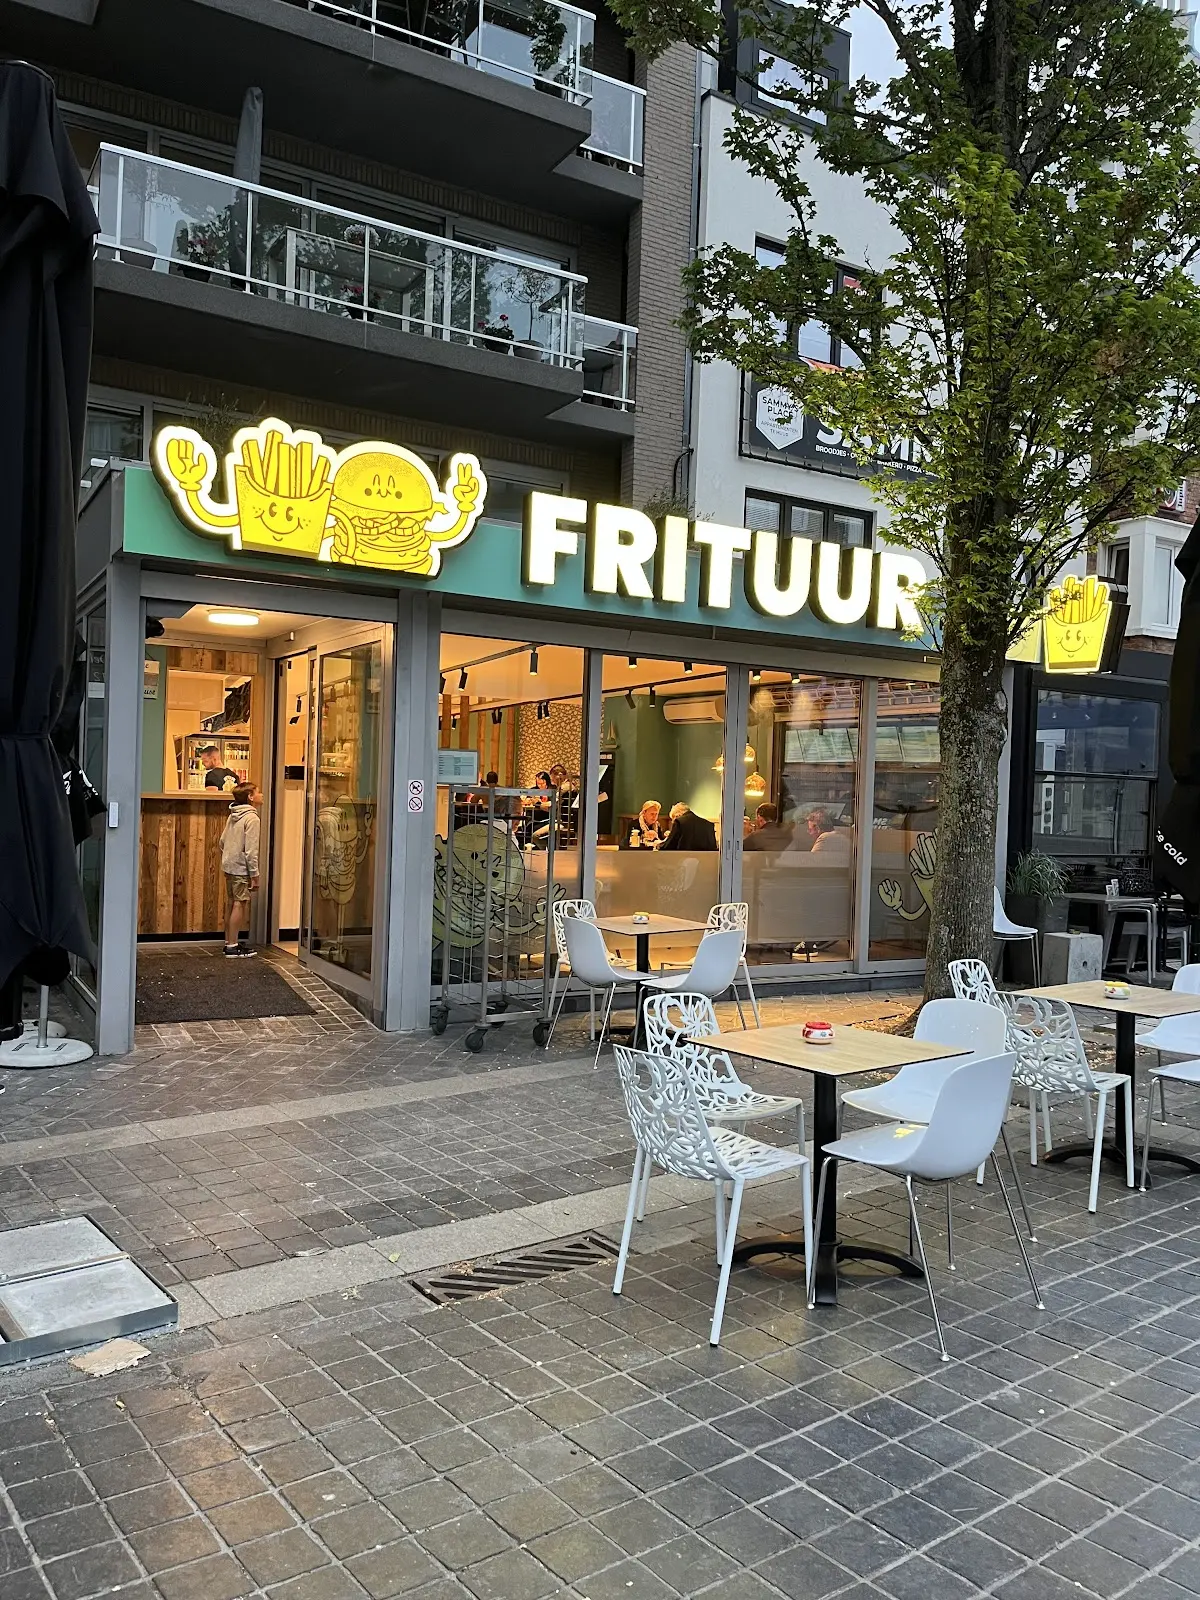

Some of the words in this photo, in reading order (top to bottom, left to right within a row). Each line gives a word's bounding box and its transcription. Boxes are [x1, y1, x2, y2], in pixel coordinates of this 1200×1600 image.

[815, 444, 847, 457] BROODJES
[906, 464, 923, 474] PIZZA
[527, 491, 928, 631] FRITUUR
[1163, 843, 1188, 866] cold
